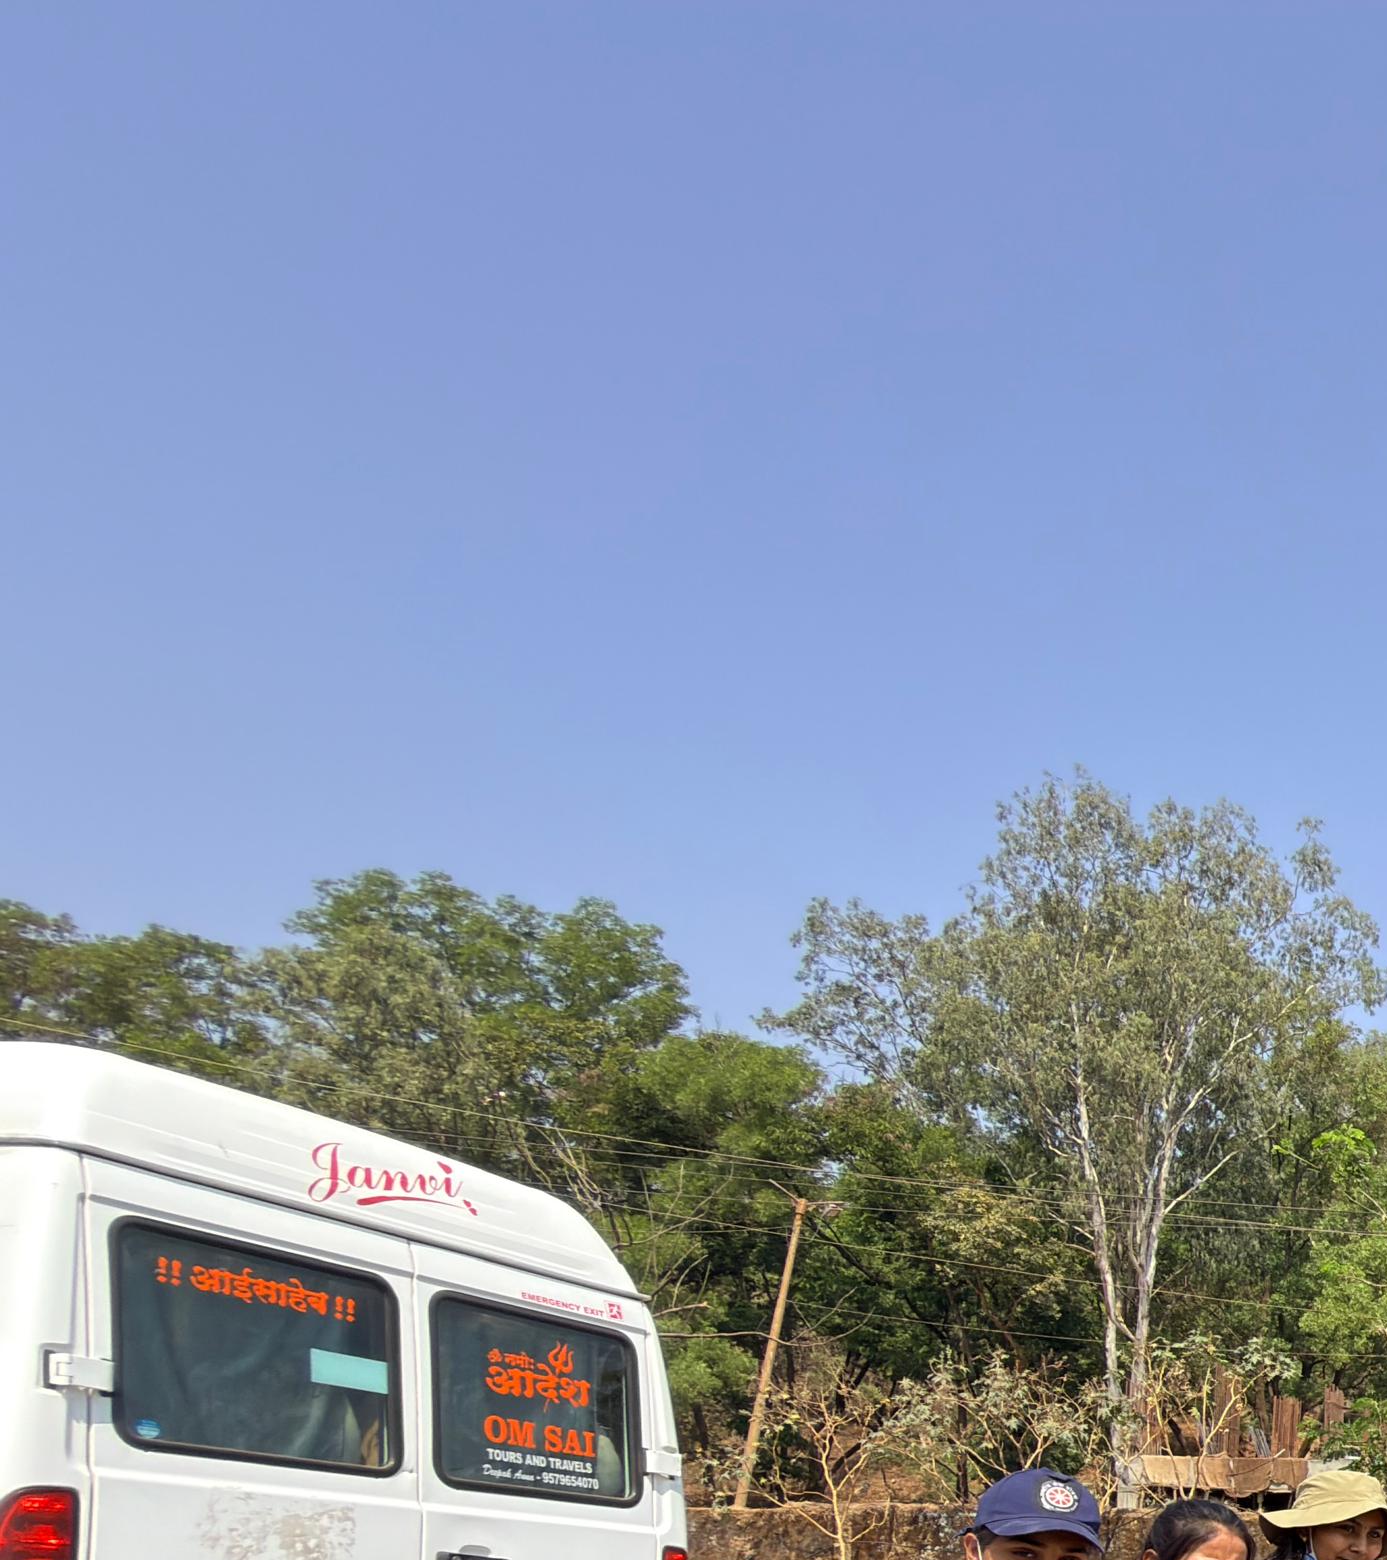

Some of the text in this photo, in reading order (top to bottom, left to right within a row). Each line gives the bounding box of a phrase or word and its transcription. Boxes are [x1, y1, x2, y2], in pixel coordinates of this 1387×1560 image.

[308, 1142, 464, 1203] Janvi
[190, 1264, 328, 1315] आईसाहेब
[521, 1291, 605, 1318] EMERGENCY EXIT
[486, 1364, 592, 1408] आदेश
[483, 1414, 596, 1458] OM SAI
[486, 1448, 593, 1474] TOURS AND TRAVELS
